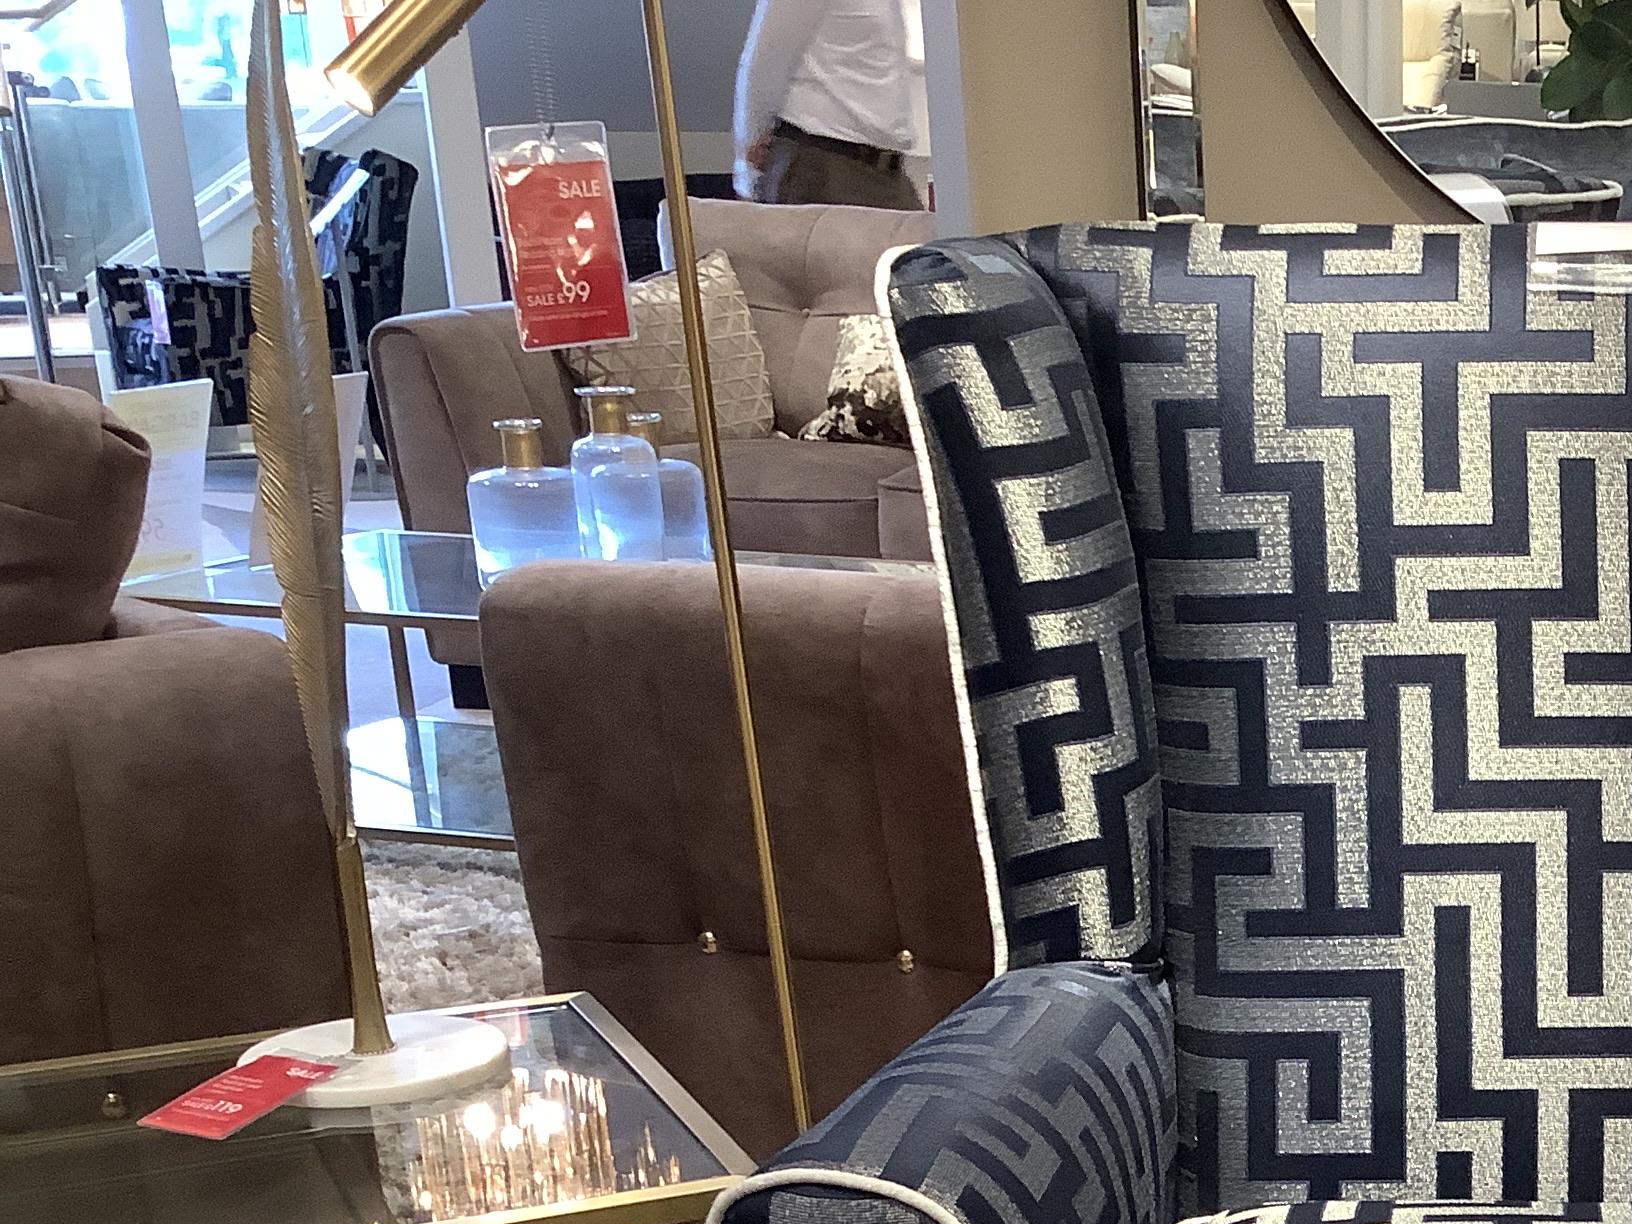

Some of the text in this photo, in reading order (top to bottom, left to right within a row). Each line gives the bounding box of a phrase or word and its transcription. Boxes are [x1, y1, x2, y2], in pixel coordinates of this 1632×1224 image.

[559, 179, 601, 198] SALE
[526, 293, 557, 308] SALE
[286, 1067, 325, 1080] SALE
